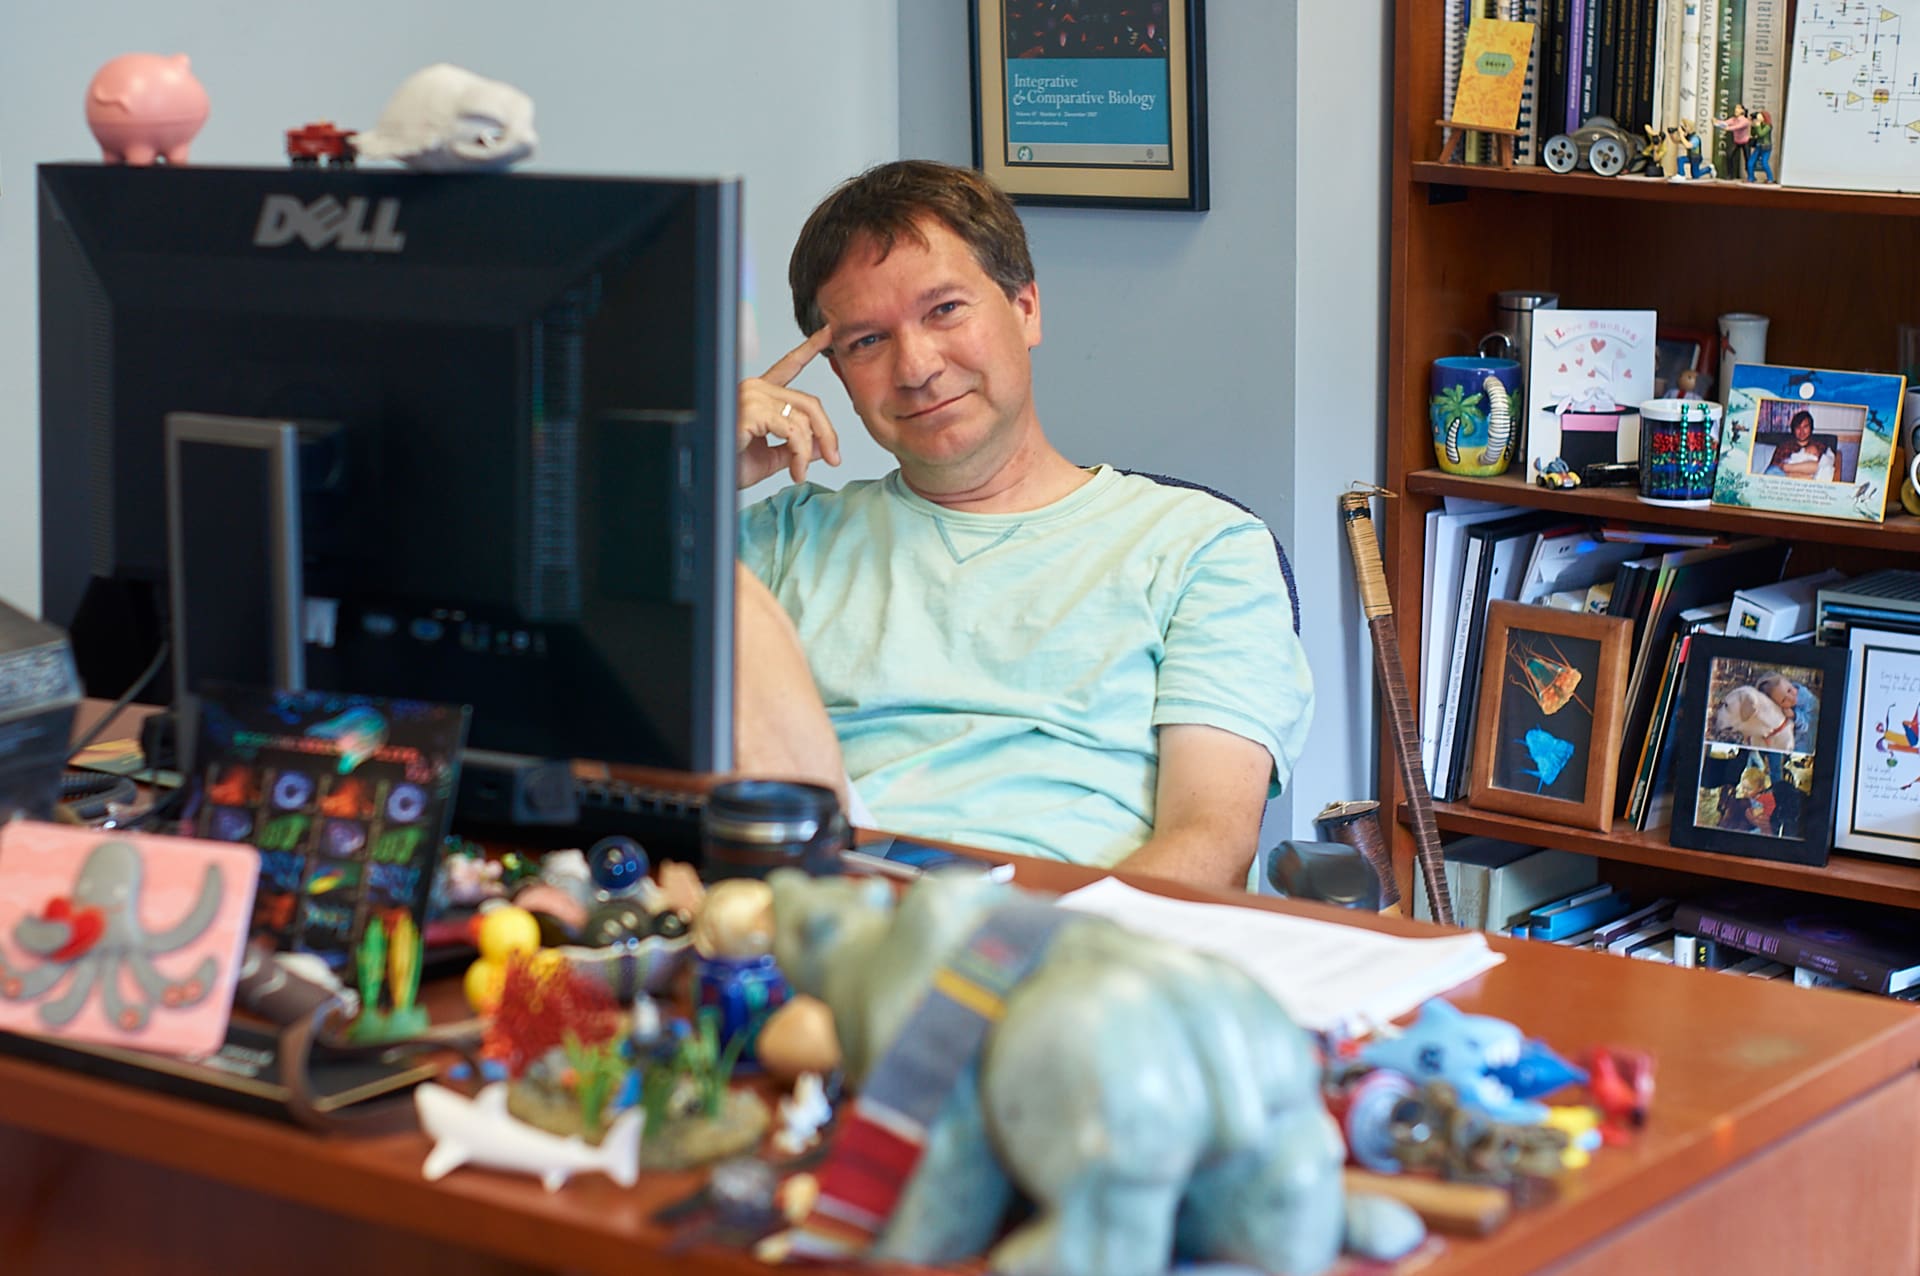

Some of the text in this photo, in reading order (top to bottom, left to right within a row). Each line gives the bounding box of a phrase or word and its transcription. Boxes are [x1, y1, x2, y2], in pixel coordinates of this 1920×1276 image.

[1014, 73, 1078, 93] Integrative
[1027, 90, 1105, 109] Comparative
[1108, 89, 1156, 110] Biology
[1699, 35, 1711, 134] EXPLANATIONS
[1718, 7, 1732, 156] BEAUTIFUL EVIDNCE
[1750, 60, 1773, 110] Analysis
[252, 193, 408, 252] DELL
